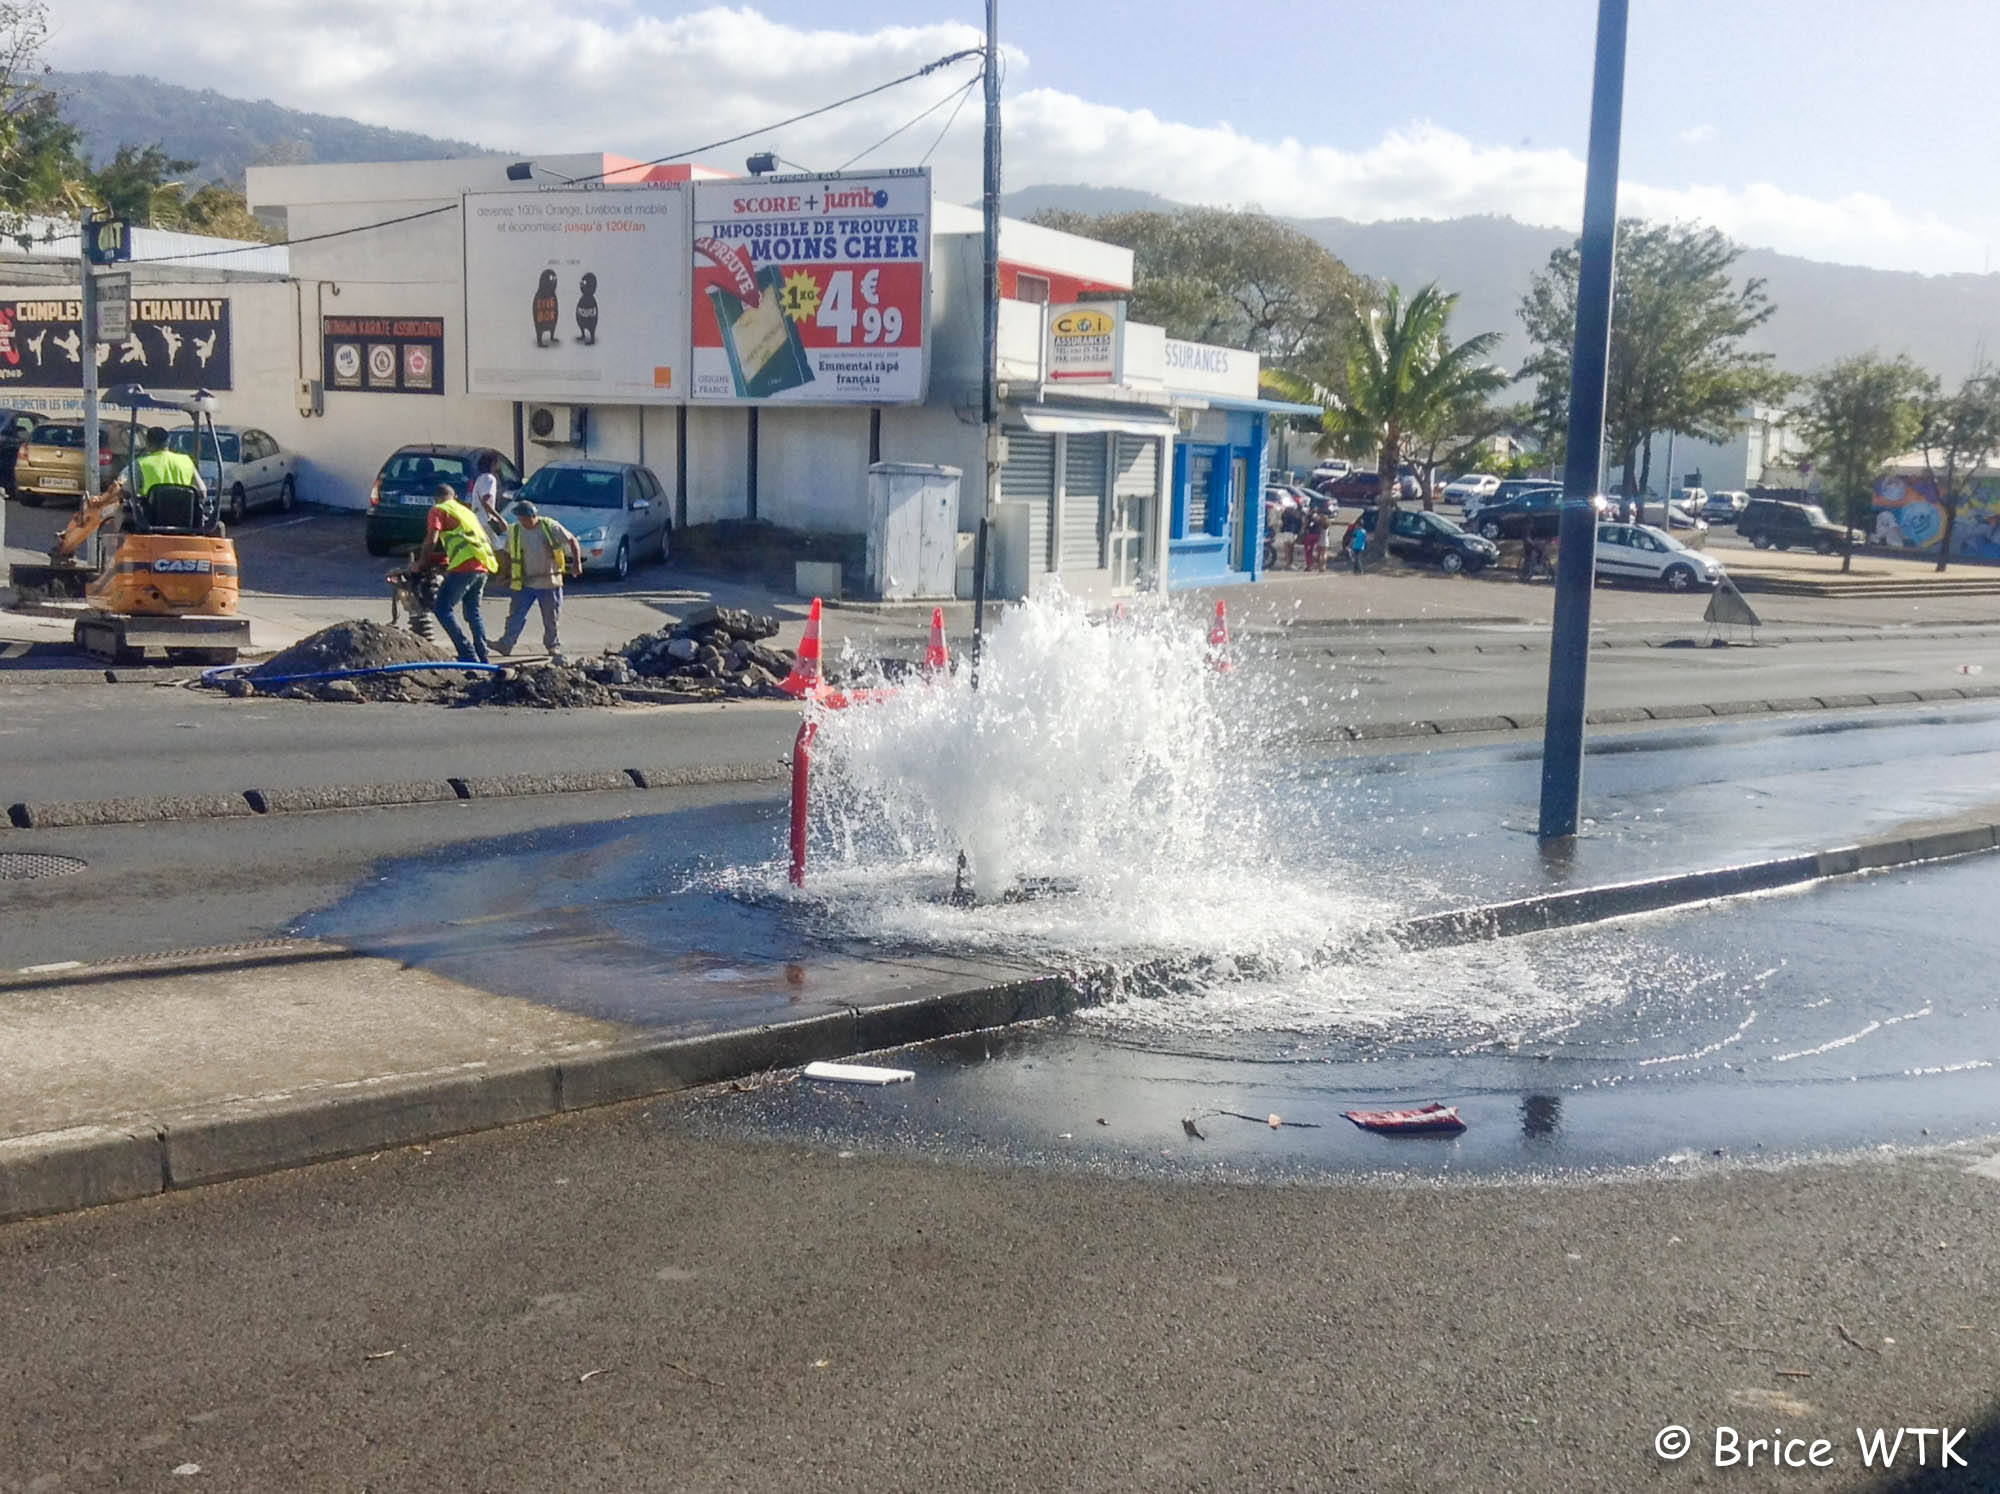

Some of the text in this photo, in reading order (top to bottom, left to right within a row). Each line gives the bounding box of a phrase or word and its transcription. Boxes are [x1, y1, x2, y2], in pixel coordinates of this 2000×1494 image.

[733, 196, 801, 214] SCORE
[822, 185, 889, 214] jumbo
[477, 203, 667, 218] devenez 100% Orange, Livebox et mobile
[497, 222, 506, 233] et
[509, 221, 563, 233] économisez
[605, 221, 646, 233] 120€/an
[712, 219, 919, 240] IMPOSSIBLE DE TROUVER
[751, 235, 919, 262] MOINS CHER
[712, 241, 756, 295] PREUVE
[141, 301, 182, 321] CHAN
[186, 301, 223, 320] LIAT
[359, 320, 391, 336] KARATE
[1054, 335, 1111, 346] ASSURANCES
[818, 360, 900, 374] Emmental râpé
[698, 375, 729, 384] ORIGINE
[836, 373, 881, 386] français
[699, 384, 729, 393] FRANCE
[13, 399, 47, 410] RESPECTER
[50, 399, 61, 410] LES
[154, 558, 211, 572] CASE
